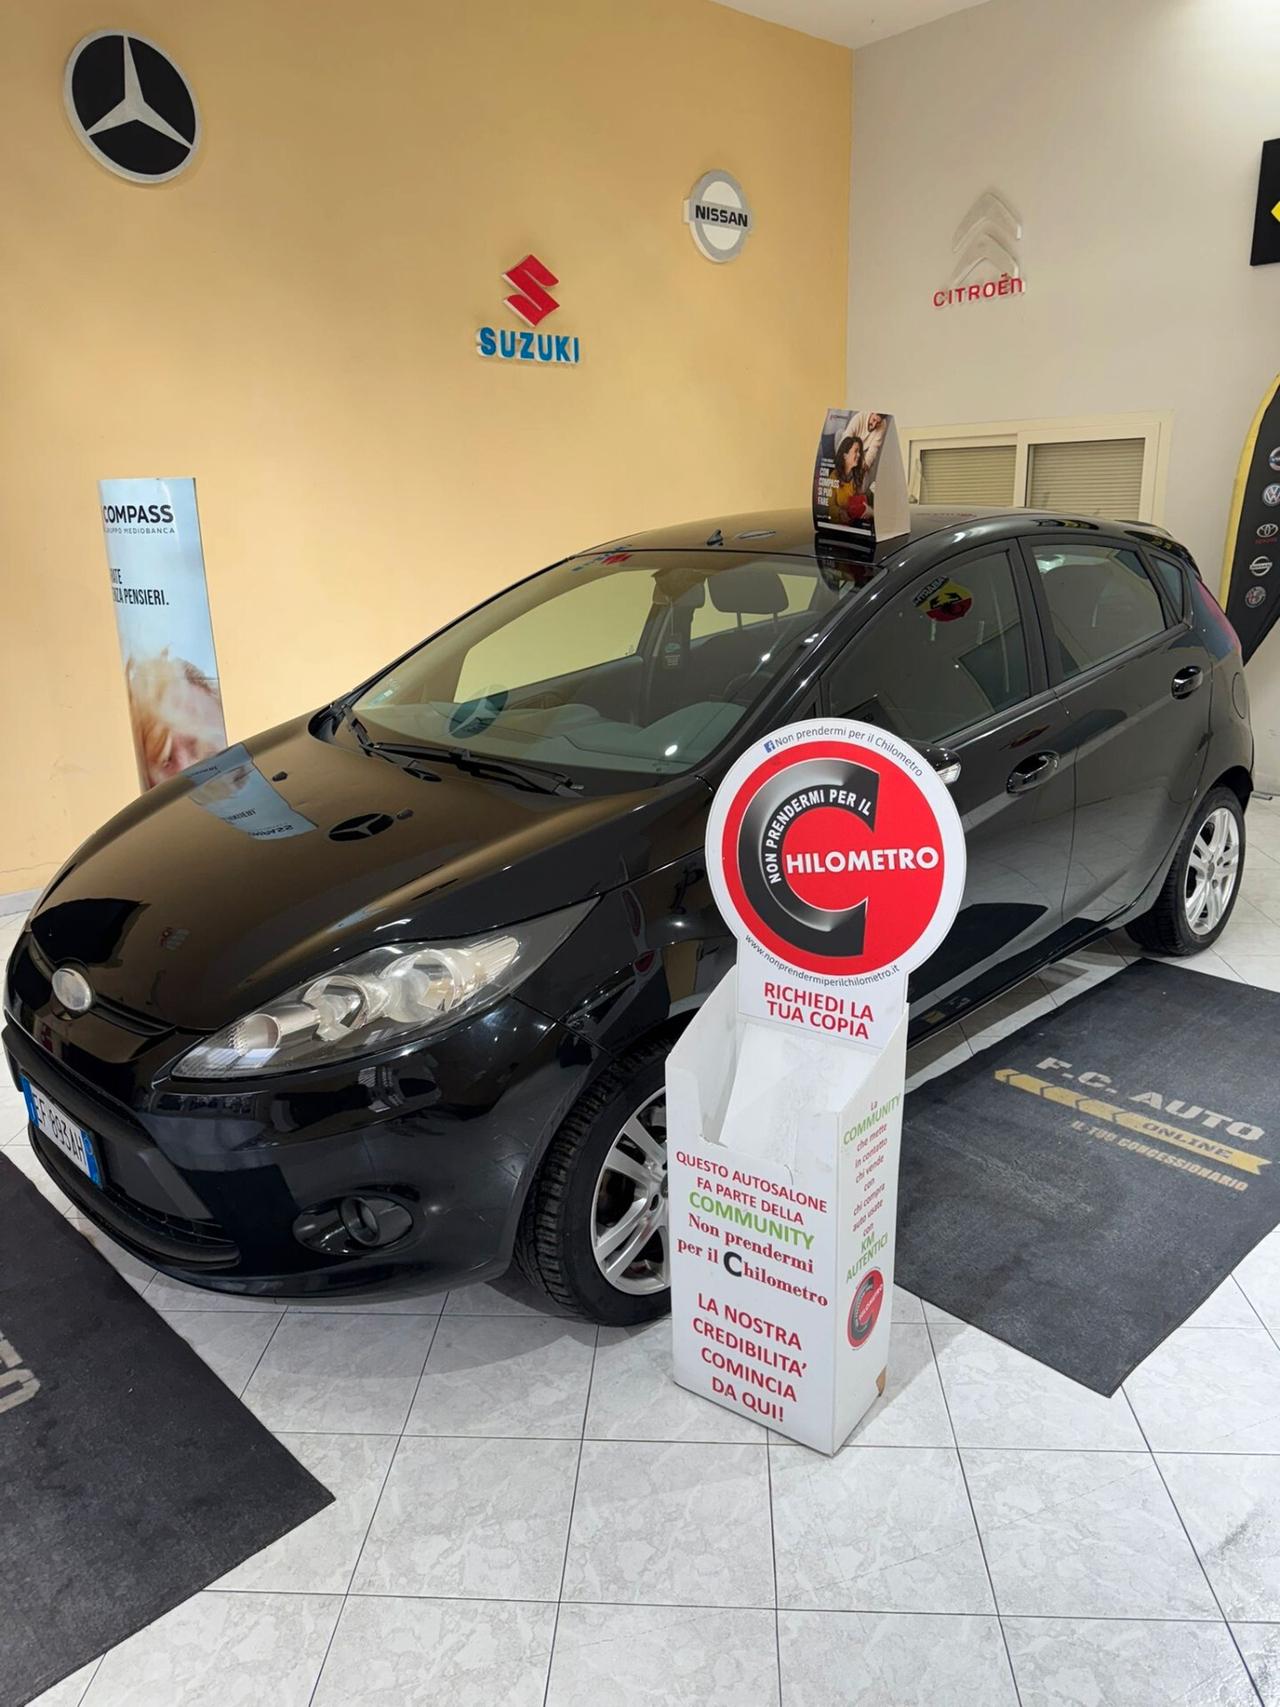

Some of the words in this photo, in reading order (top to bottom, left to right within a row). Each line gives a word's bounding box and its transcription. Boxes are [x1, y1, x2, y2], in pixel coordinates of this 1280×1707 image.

[695, 204, 748, 228] NISSAN
[479, 326, 580, 363] SUZUKI
[123, 527, 175, 535] MEDIOBANCA
[123, 588, 170, 606] PENSIERI.
[774, 734, 794, 747] Non
[796, 726, 846, 742] prendermi
[848, 729, 866, 740] per
[867, 733, 875, 743] il
[875, 736, 923, 777] Chilometro
[765, 789, 825, 849] PRENDERMI
[829, 788, 857, 808] PER
[858, 798, 872, 816] IL
[765, 853, 782, 884] NON
[745, 934, 900, 987] www.nonprendermiperilchilometro.it
[764, 982, 844, 1015] RICHIEDI
[850, 1001, 874, 1023] LA
[766, 1000, 804, 1024] TUA
[809, 1011, 869, 1040] COPIA
[843, 1092, 901, 1145] COMMUNITY
[1128, 1091, 1265, 1141] AUTO
[1142, 1121, 1234, 1160] ONLINE
[676, 1151, 729, 1179] QUESTO
[732, 1170, 828, 1213] AUTOSALONE
[1085, 1124, 1118, 1145] TUO
[1116, 1137, 1249, 1193] CONCESSIONARIO
[688, 1191, 815, 1250] COMMUNITY
[696, 1176, 712, 1192] FA
[716, 1183, 757, 1208] PARTE
[761, 1199, 804, 1226] DELLA
[688, 1212, 720, 1238] Non
[724, 1230, 814, 1274] prendermi
[846, 1232, 889, 1284] AUTENTICI
[861, 1231, 875, 1254] KM
[677, 1238, 703, 1257] per
[706, 1247, 719, 1264] il
[723, 1251, 829, 1307] Chilometro
[698, 1292, 719, 1316] LA
[724, 1304, 802, 1351] NOSTRA
[692, 1317, 808, 1378] CREDIBILITA'
[701, 1347, 798, 1402] COMINCIA
[712, 1376, 737, 1401] DA
[742, 1391, 784, 1423] QUI!
